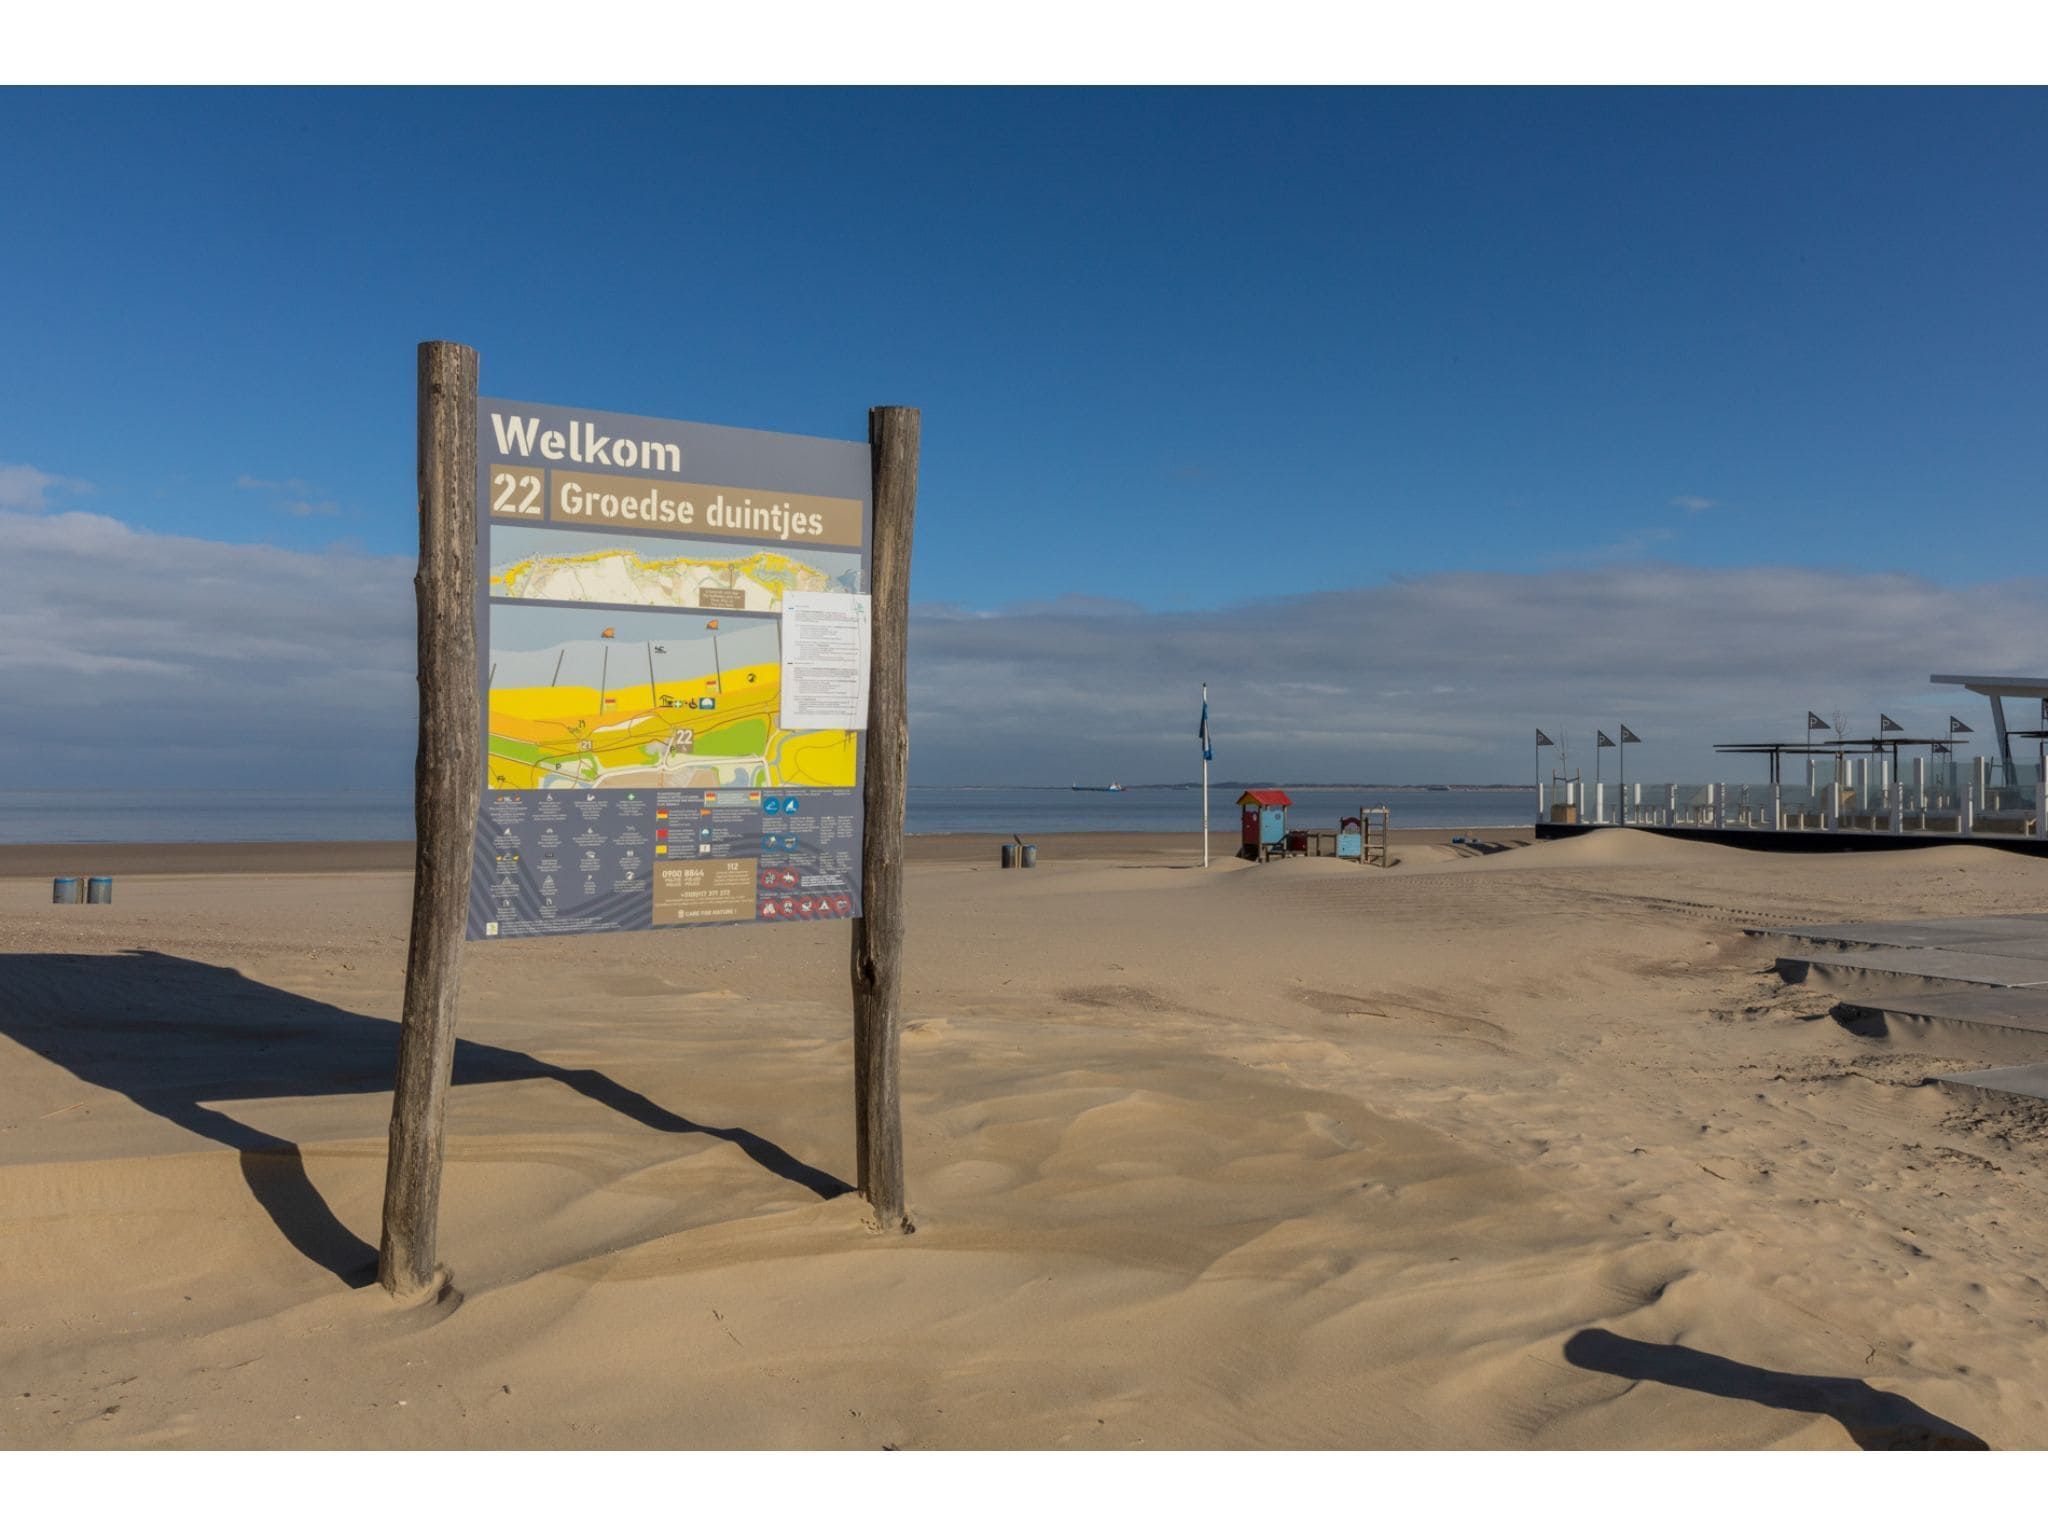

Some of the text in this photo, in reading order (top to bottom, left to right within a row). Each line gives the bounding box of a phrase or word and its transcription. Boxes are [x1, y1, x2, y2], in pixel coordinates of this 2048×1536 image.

[490, 413, 681, 472] Welkom
[493, 473, 824, 541] 22 Groedse duintjes
[582, 741, 592, 749] 21
[676, 730, 693, 744] 22
